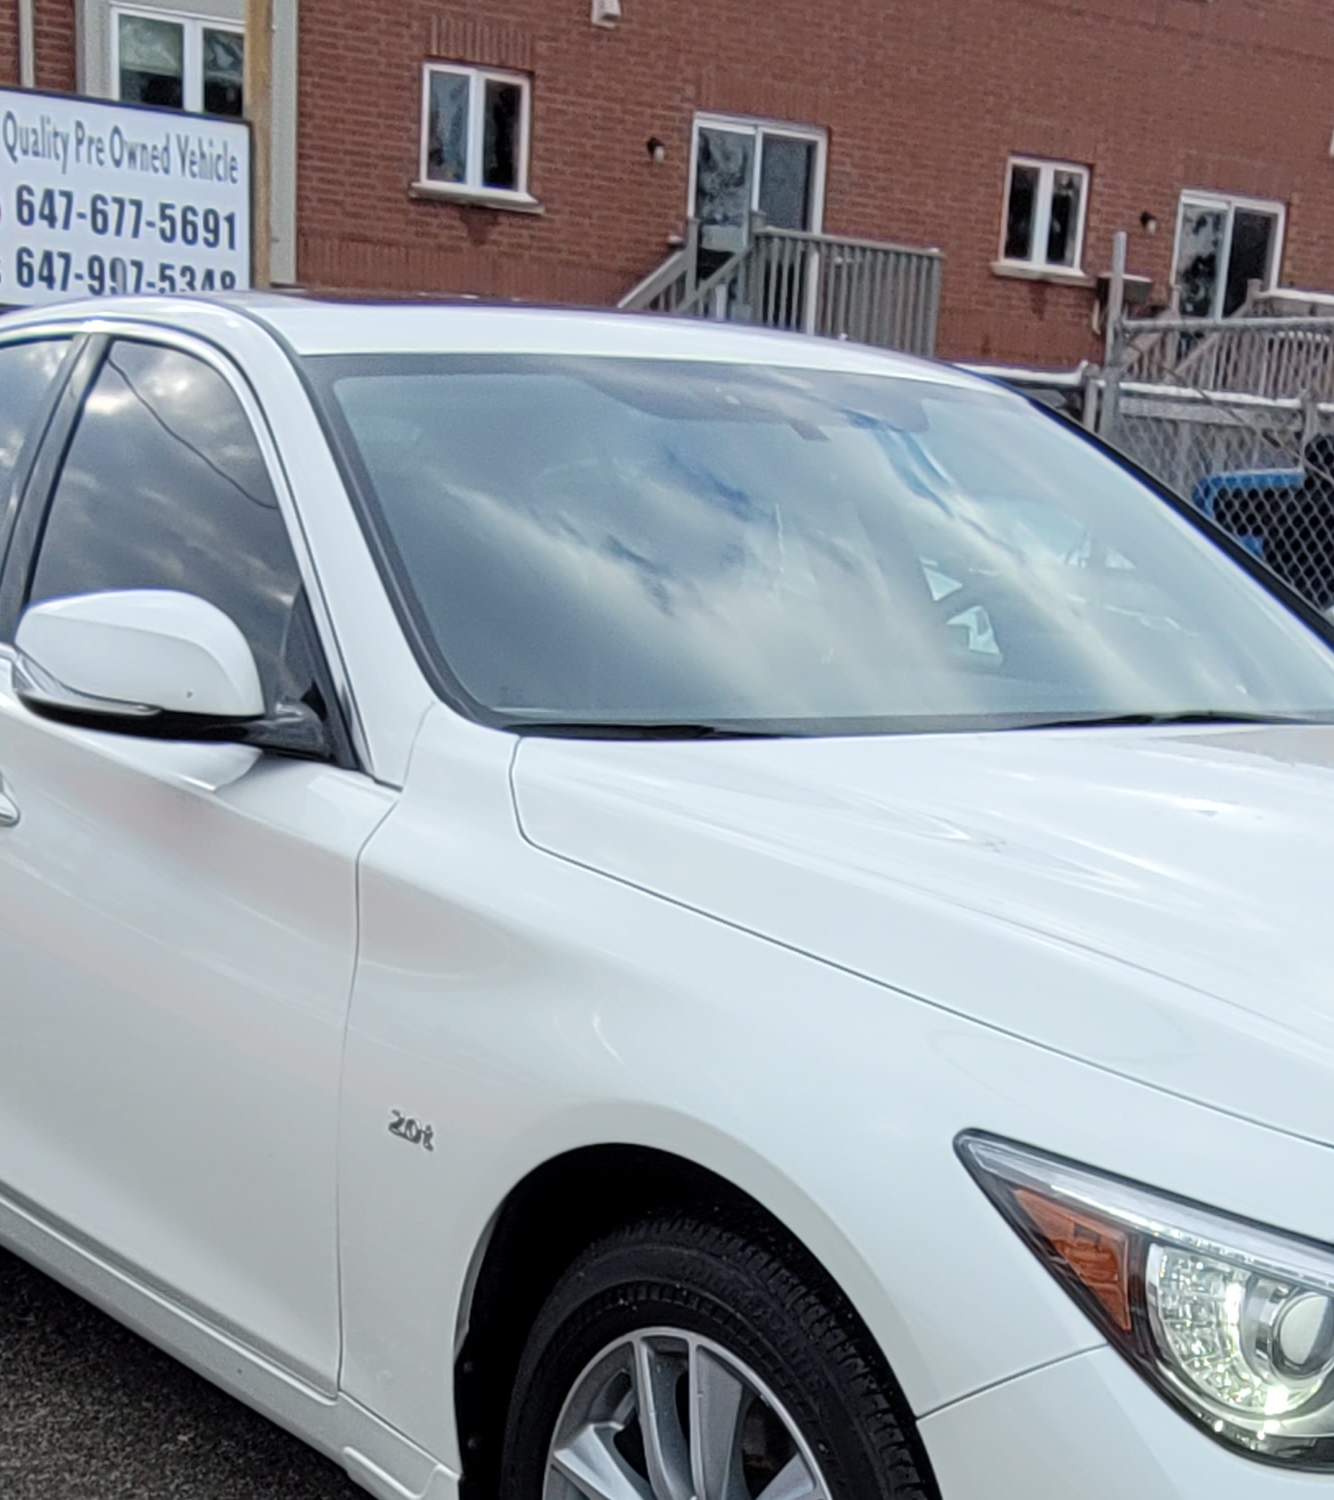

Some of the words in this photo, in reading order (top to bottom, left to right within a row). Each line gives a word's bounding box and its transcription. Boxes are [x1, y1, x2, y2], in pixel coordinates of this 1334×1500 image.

[2, 110, 69, 175] Quality
[74, 120, 105, 167] Pre
[109, 124, 171, 175] Owned
[176, 134, 238, 184] Vehicle
[16, 184, 236, 251] 647-677-5691
